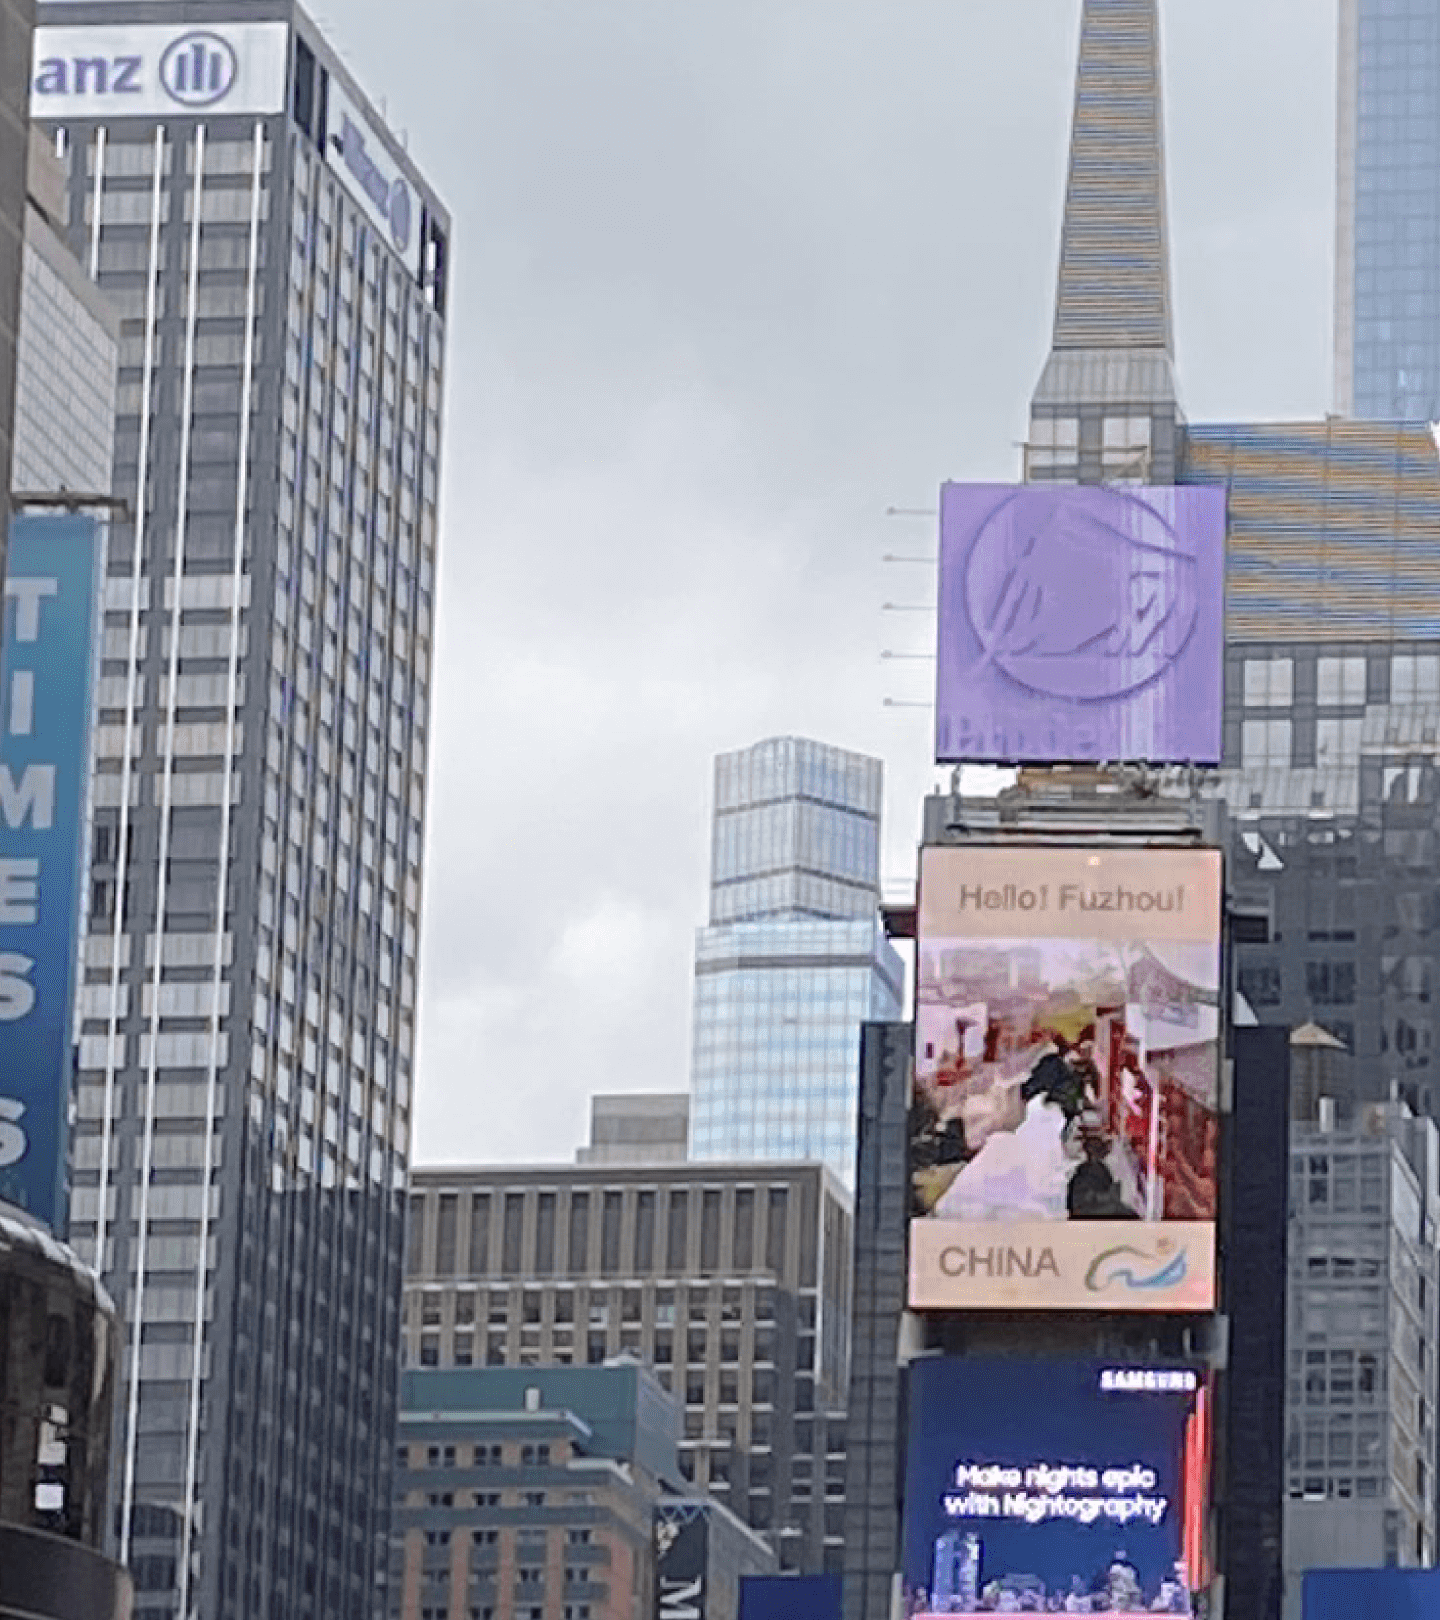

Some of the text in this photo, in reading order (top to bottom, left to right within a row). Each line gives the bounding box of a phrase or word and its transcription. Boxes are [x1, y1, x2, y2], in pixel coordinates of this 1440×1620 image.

[959, 883, 1185, 914] Hello! Fuzhou!
[939, 1246, 1060, 1278] CHINA
[955, 1463, 1157, 1495] Make nights epic
[943, 1491, 1001, 1517] with
